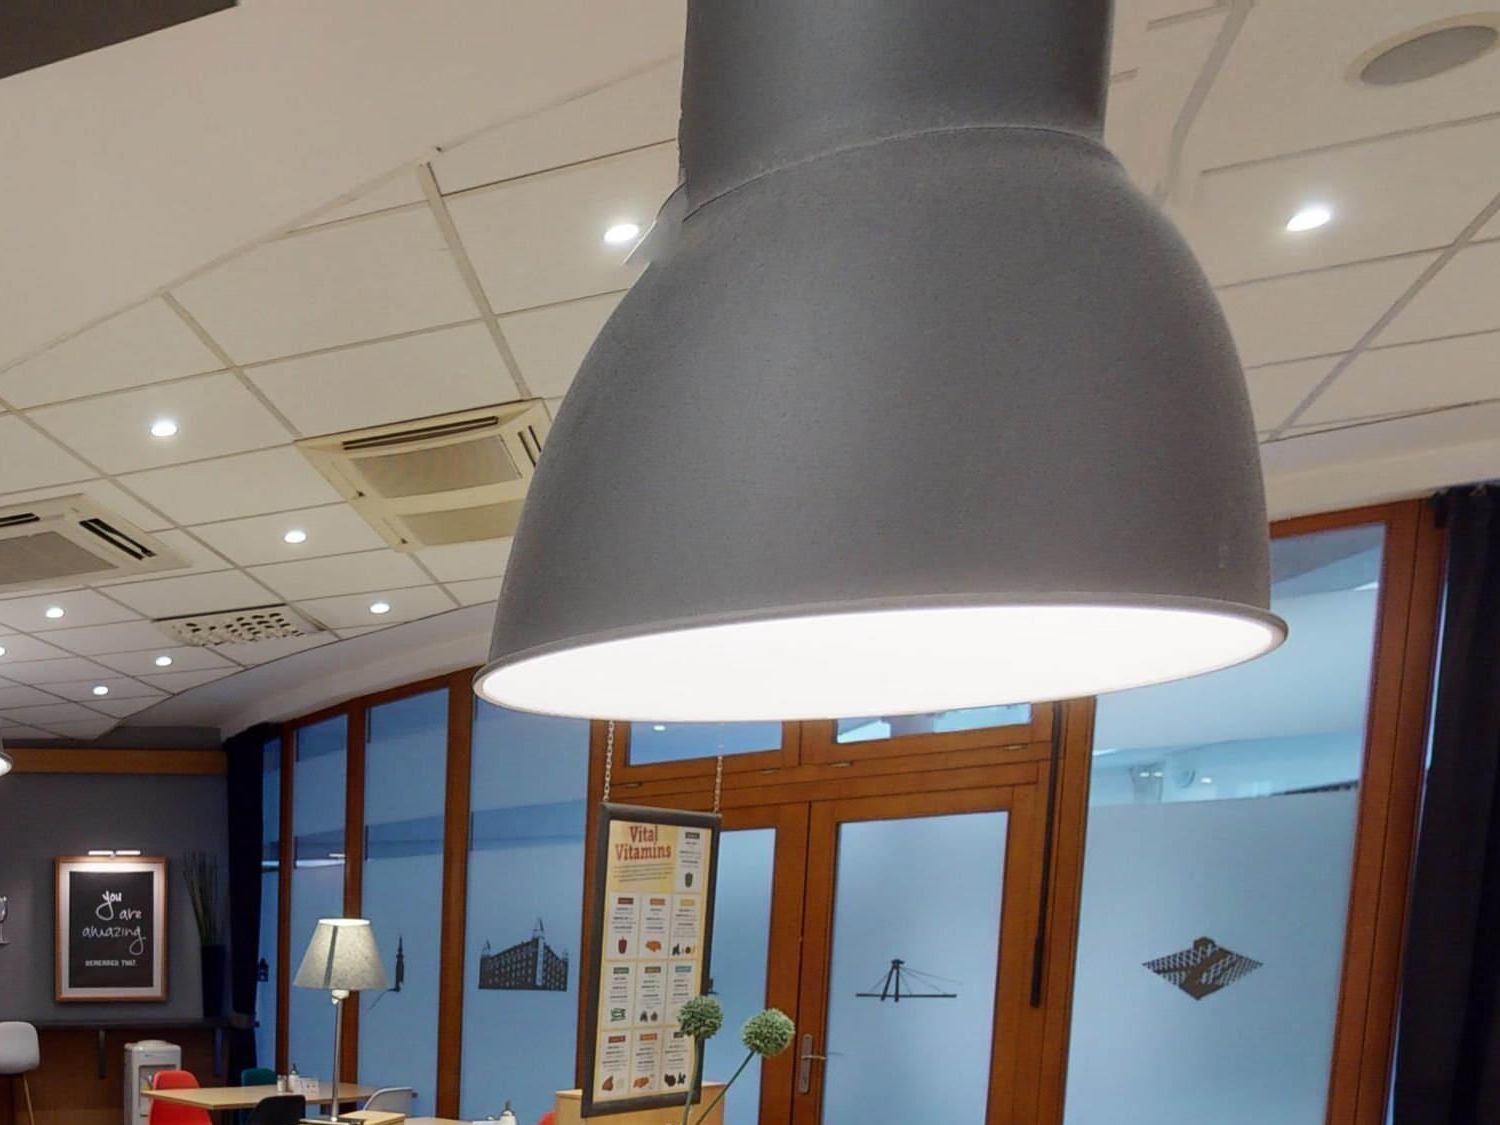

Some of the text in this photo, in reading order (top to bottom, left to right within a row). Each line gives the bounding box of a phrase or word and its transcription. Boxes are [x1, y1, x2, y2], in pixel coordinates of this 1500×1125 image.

[629, 825, 659, 843] Vital
[615, 843, 672, 861] Vitamins
[95, 890, 122, 921] you
[119, 908, 142, 921] are
[82, 924, 147, 956] amazing
